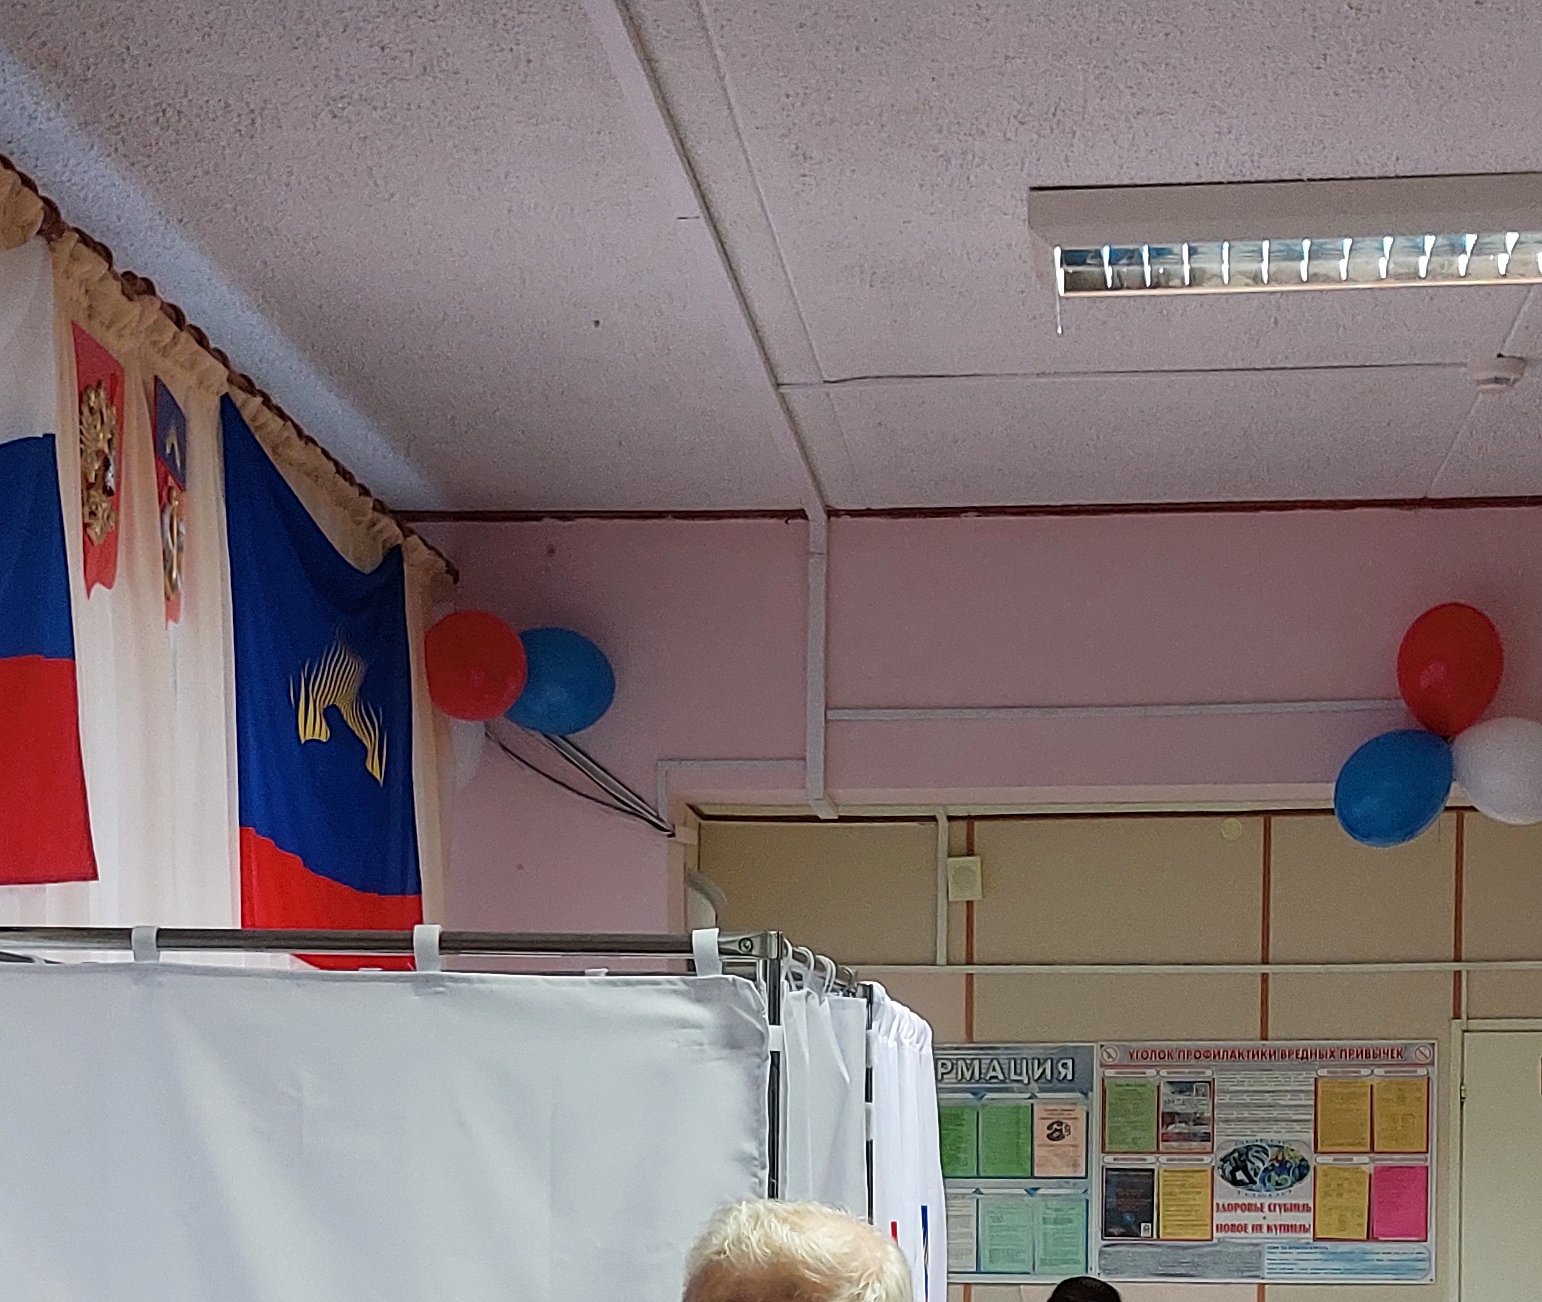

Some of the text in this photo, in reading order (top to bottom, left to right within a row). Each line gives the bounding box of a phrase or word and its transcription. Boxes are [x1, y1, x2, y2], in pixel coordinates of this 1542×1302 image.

[1128, 1048, 1403, 1061] УГОЛОК ПРОФИЛАКТИКИ ВРЕДНЫХ ПРИВЫЧЕК
